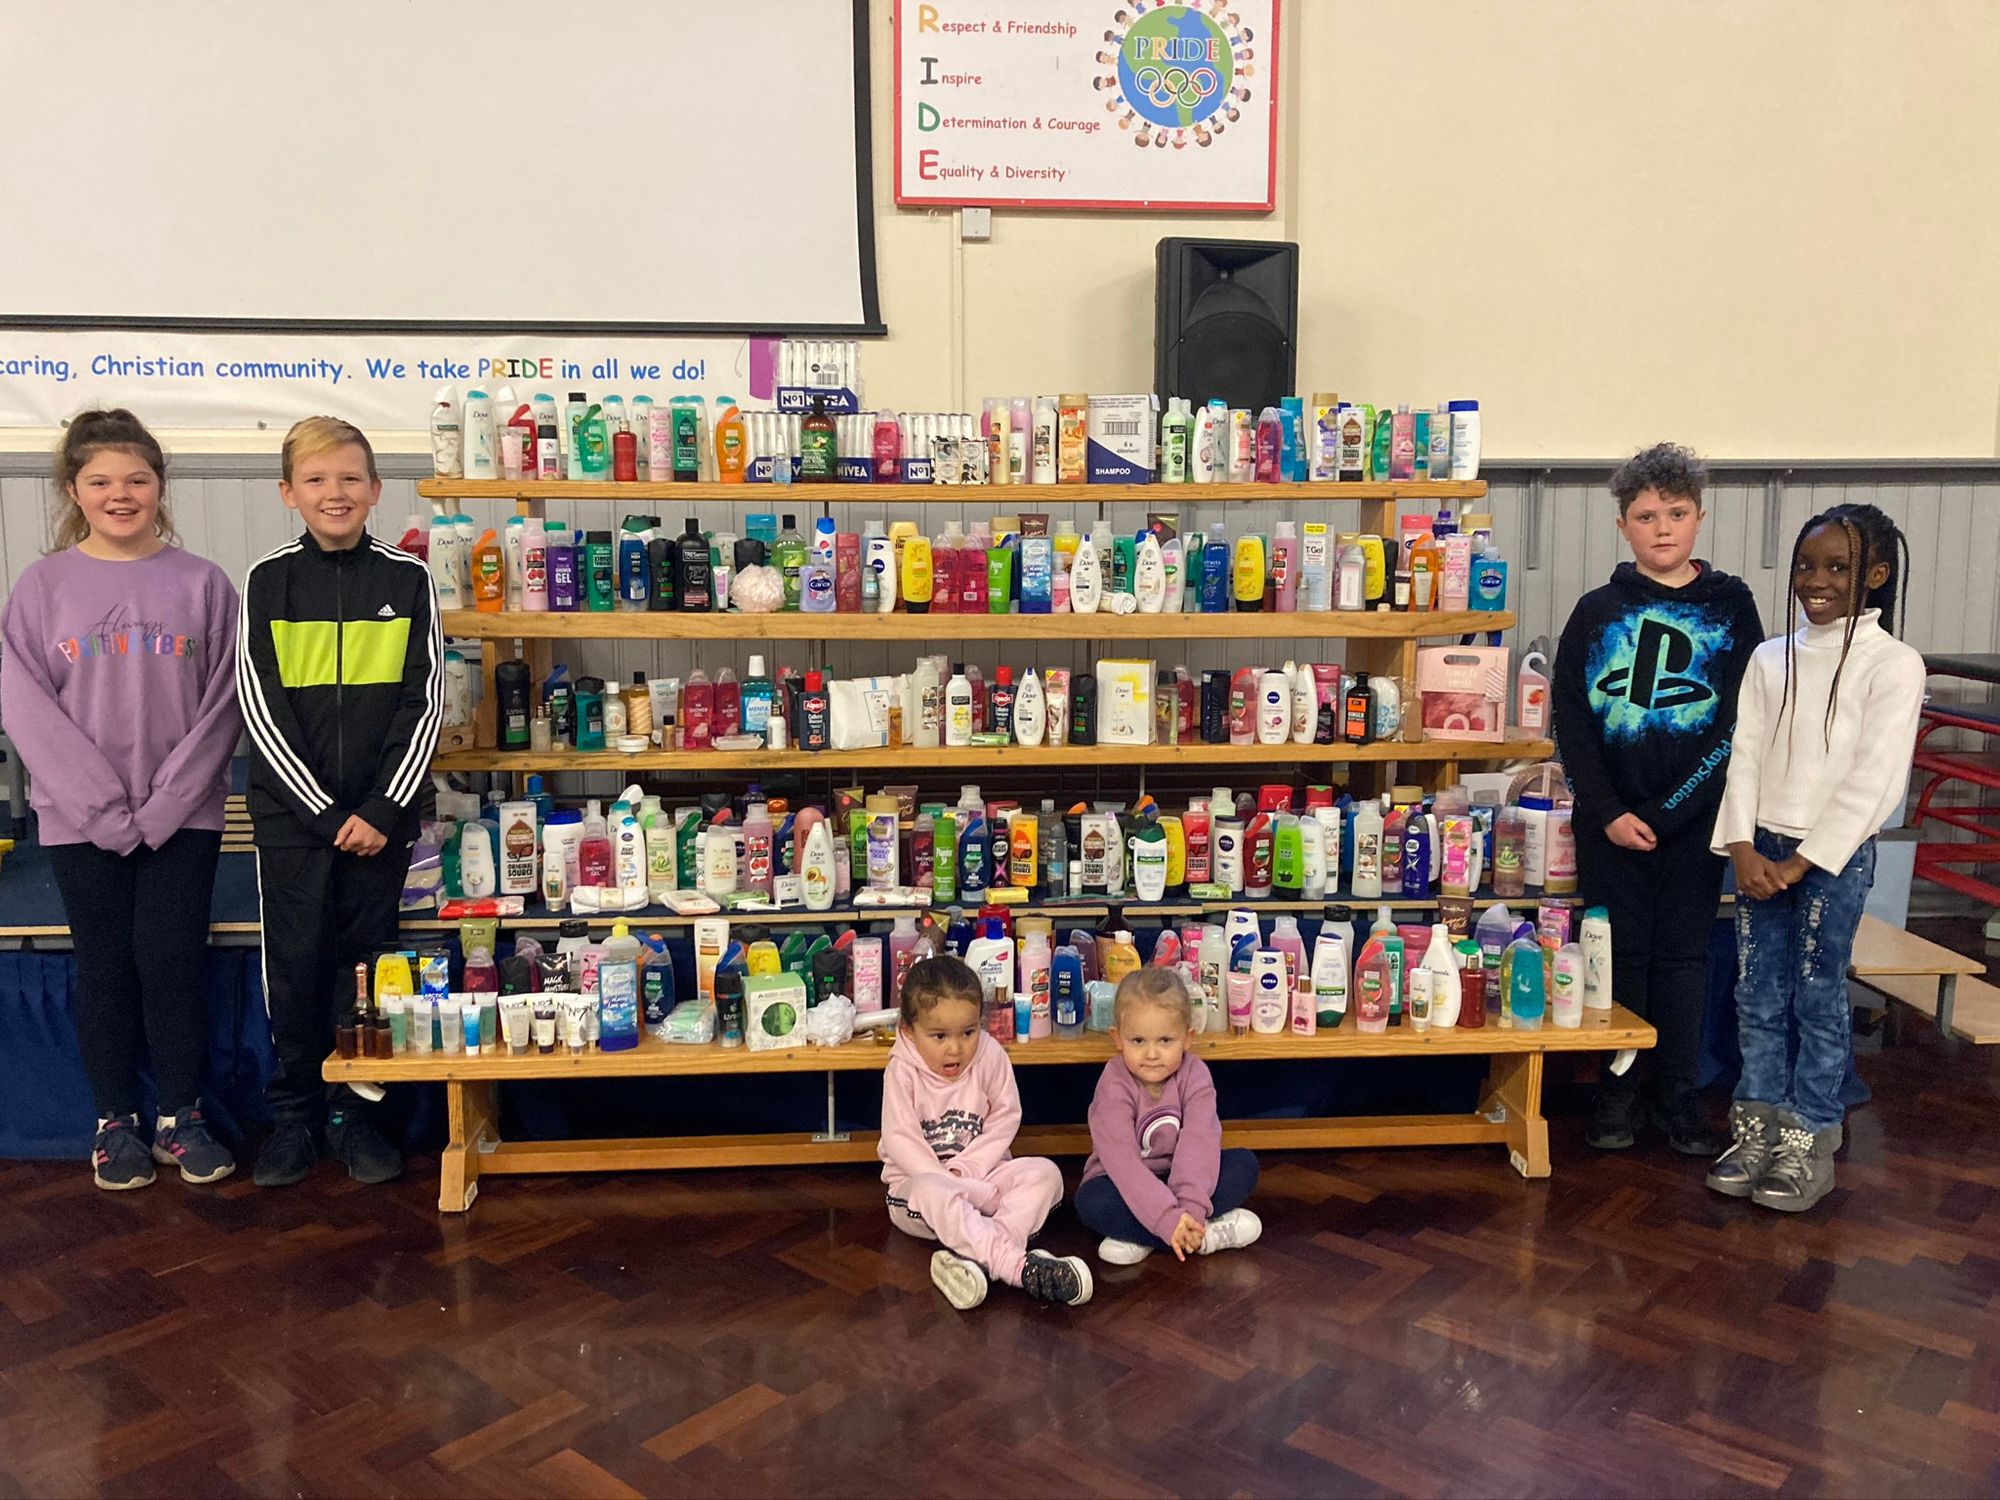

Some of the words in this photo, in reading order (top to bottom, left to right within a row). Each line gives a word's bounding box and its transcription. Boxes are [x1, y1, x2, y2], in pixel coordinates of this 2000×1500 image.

[919, 4, 986, 34] Respect
[993, 21, 1001, 33] &
[1007, 20, 1077, 38] Friendship
[1135, 36, 1220, 62] PRIDE
[919, 57, 983, 86] Inspire
[918, 102, 1027, 132] Determination
[1033, 118, 1041, 130] &
[1048, 117, 1101, 132] Courage
[919, 149, 984, 181] Equality
[990, 166, 1000, 178] &
[1005, 165, 1066, 183] Diversity
[91, 355, 204, 378] Christian
[216, 358, 353, 384] community.
[366, 358, 406, 379] We
[417, 358, 470, 379] take
[478, 358, 554, 379] PRIDE
[561, 359, 581, 379] in
[592, 357, 619, 379] all
[630, 363, 660, 379] we
[672, 359, 705, 380] do!
[806, 395, 849, 406] NVEA
[472, 410, 489, 418] Dove
[538, 412, 554, 420] Dove
[437, 538, 454, 546] Dove
[556, 573, 572, 583] GEL
[1664, 739, 1732, 810] PlayStation
[1585, 931, 1603, 940] Dove
